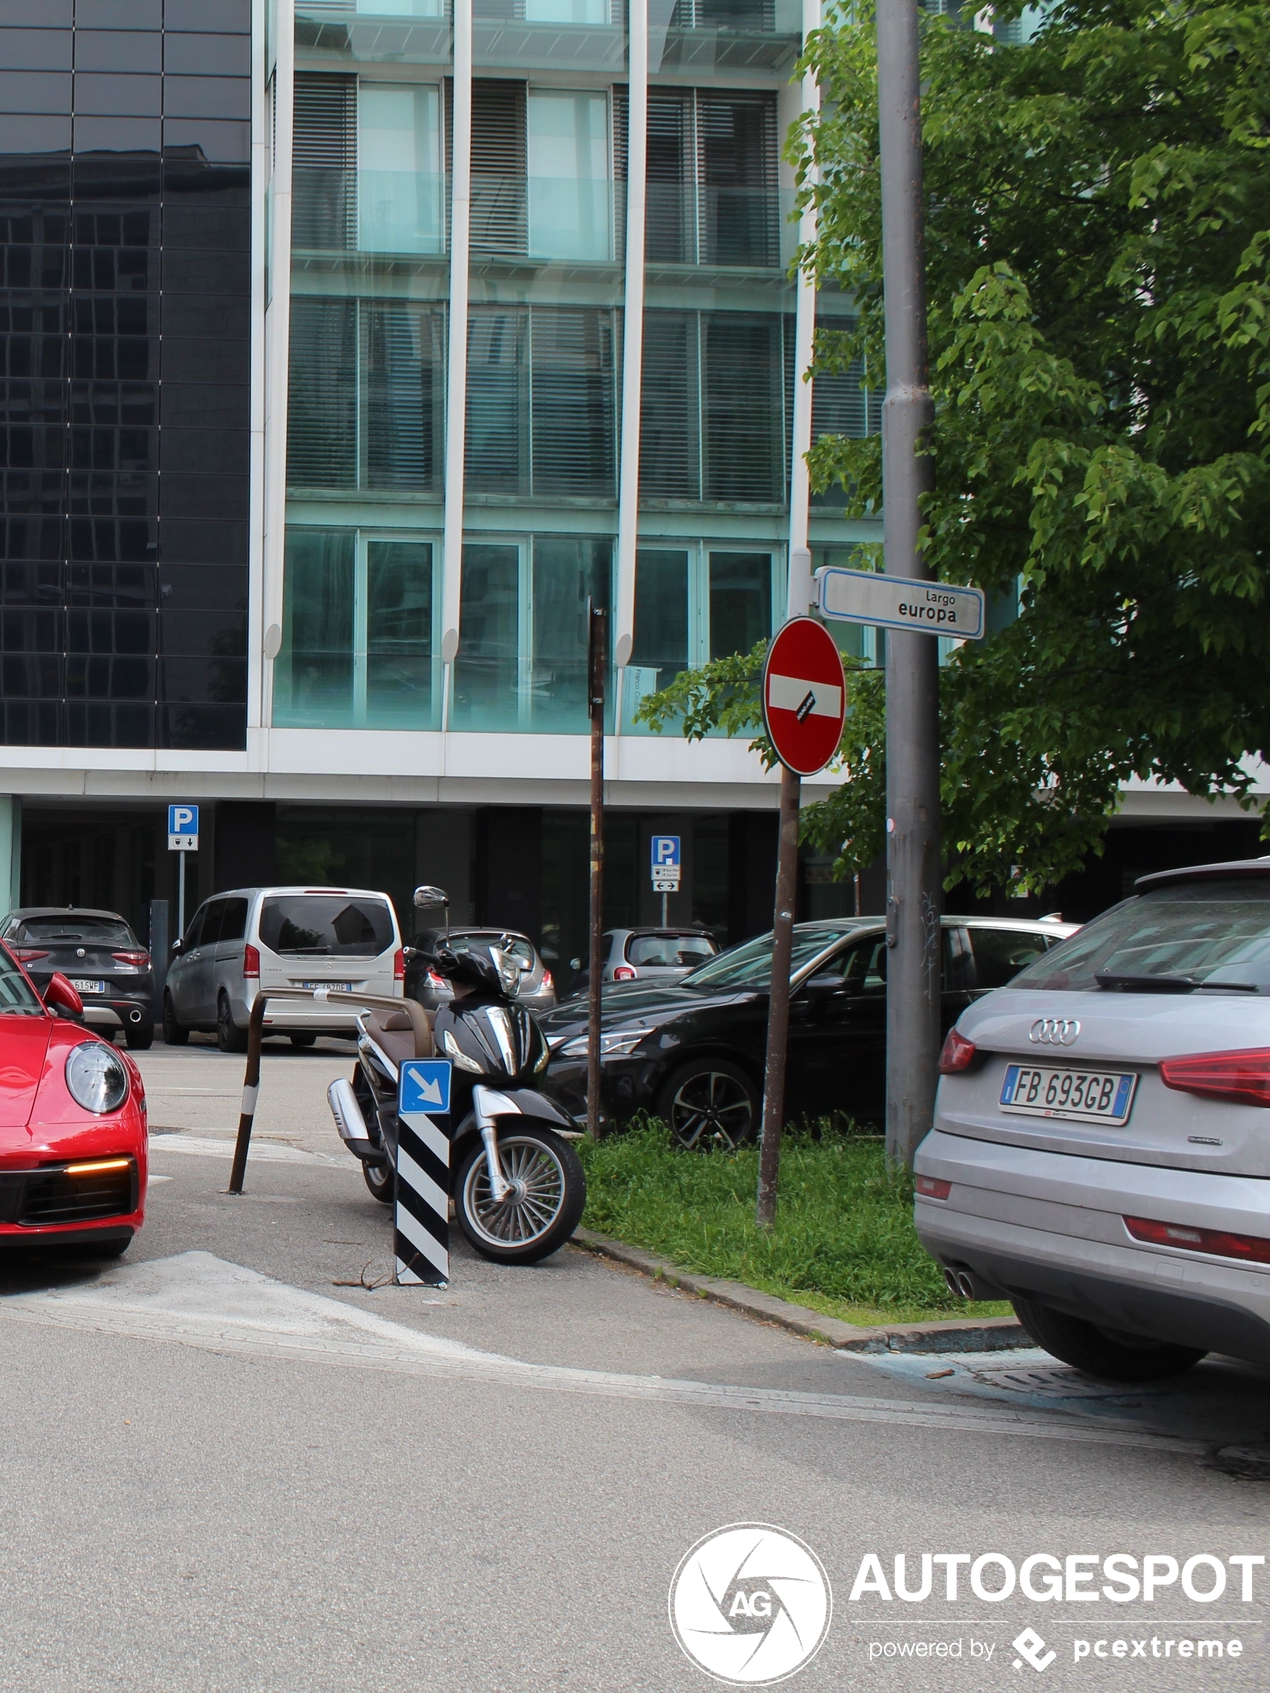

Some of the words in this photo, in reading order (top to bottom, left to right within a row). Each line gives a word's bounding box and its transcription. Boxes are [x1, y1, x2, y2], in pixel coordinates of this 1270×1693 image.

[926, 590, 956, 606] Largo
[898, 603, 956, 623] europa
[174, 808, 192, 832] P
[657, 839, 675, 863] P
